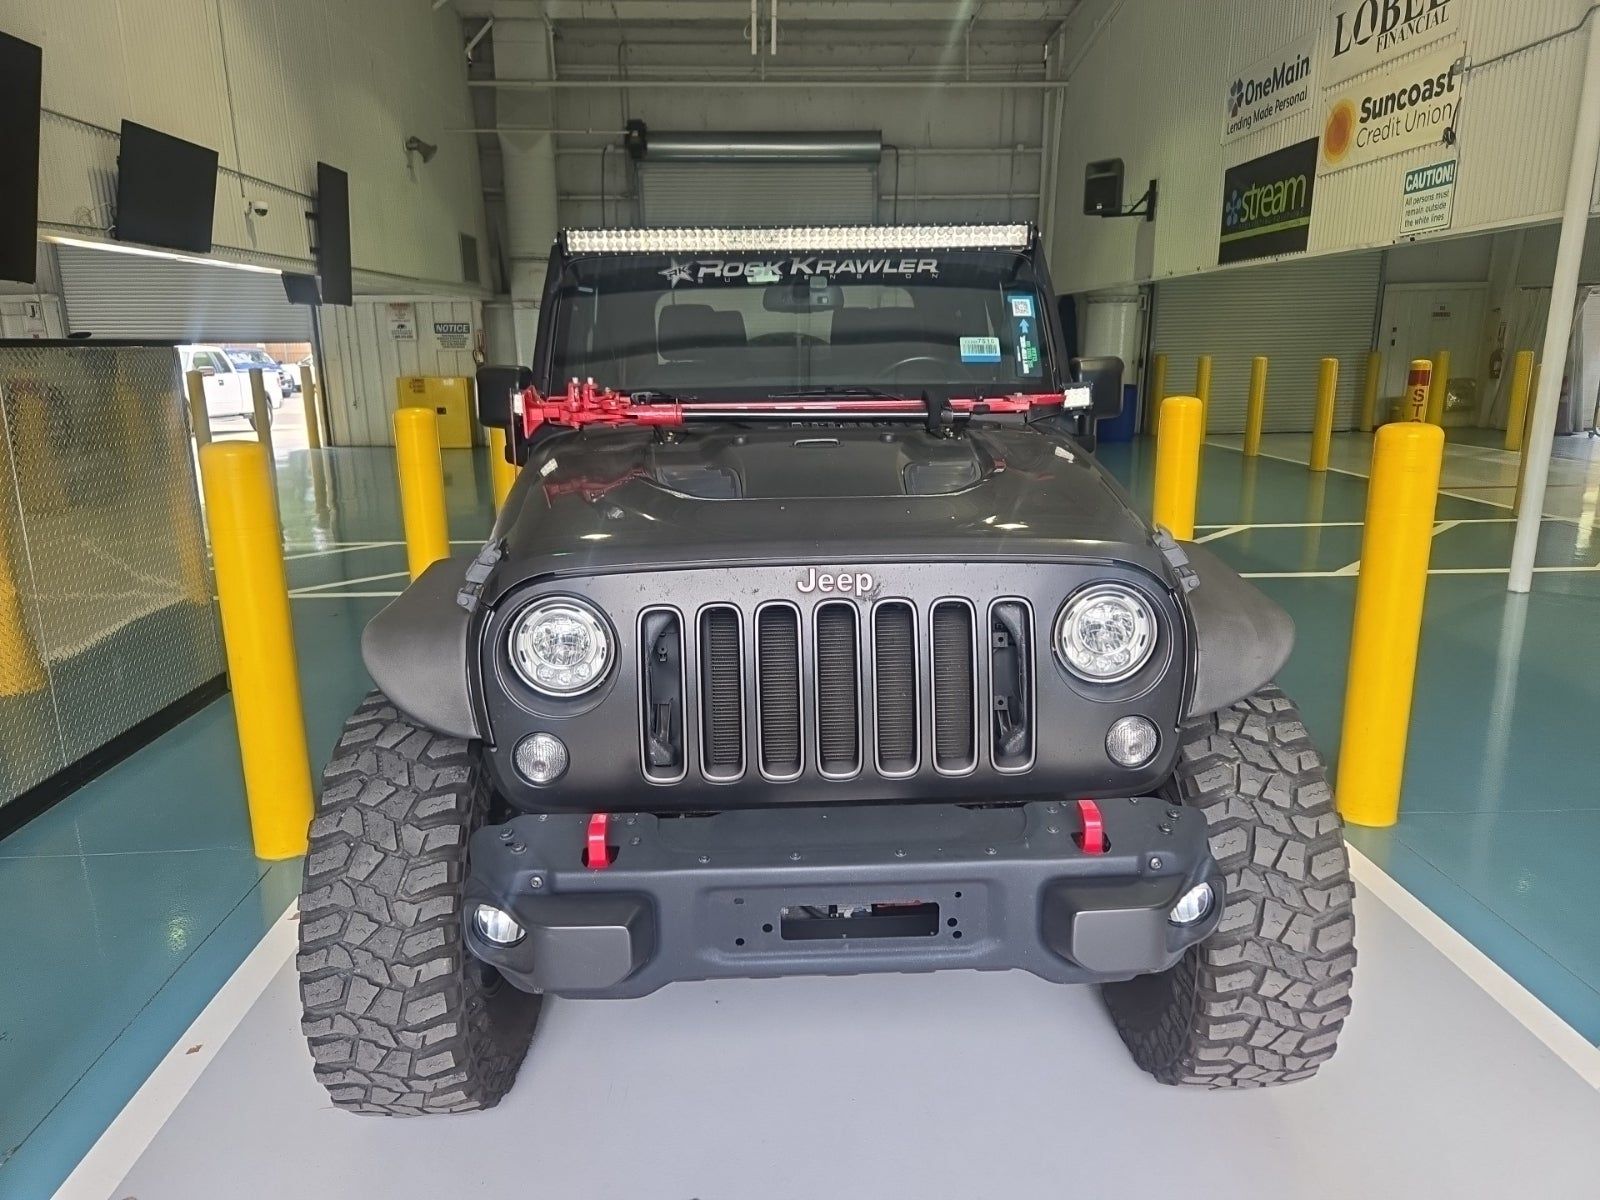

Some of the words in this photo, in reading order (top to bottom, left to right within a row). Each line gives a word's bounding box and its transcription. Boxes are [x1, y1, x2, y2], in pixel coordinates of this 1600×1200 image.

[1376, 5, 1450, 53] FINANCIAL
[1245, 54, 1310, 106] OneMain
[1359, 64, 1455, 123] Suncoast
[1227, 115, 1252, 135] Lending
[1253, 103, 1273, 123] Made
[1275, 85, 1308, 114] Personal
[1356, 116, 1401, 148] Credit
[1405, 102, 1453, 133] Union
[1405, 164, 1454, 191] CAUTION!
[1240, 174, 1307, 223] stream
[697, 274, 939, 284] SUPENSION
[790, 256, 940, 275] KRAWLER
[435, 325, 468, 333] NOTICE
[1411, 388, 1425, 422] ST
[796, 567, 874, 597] Jeep
